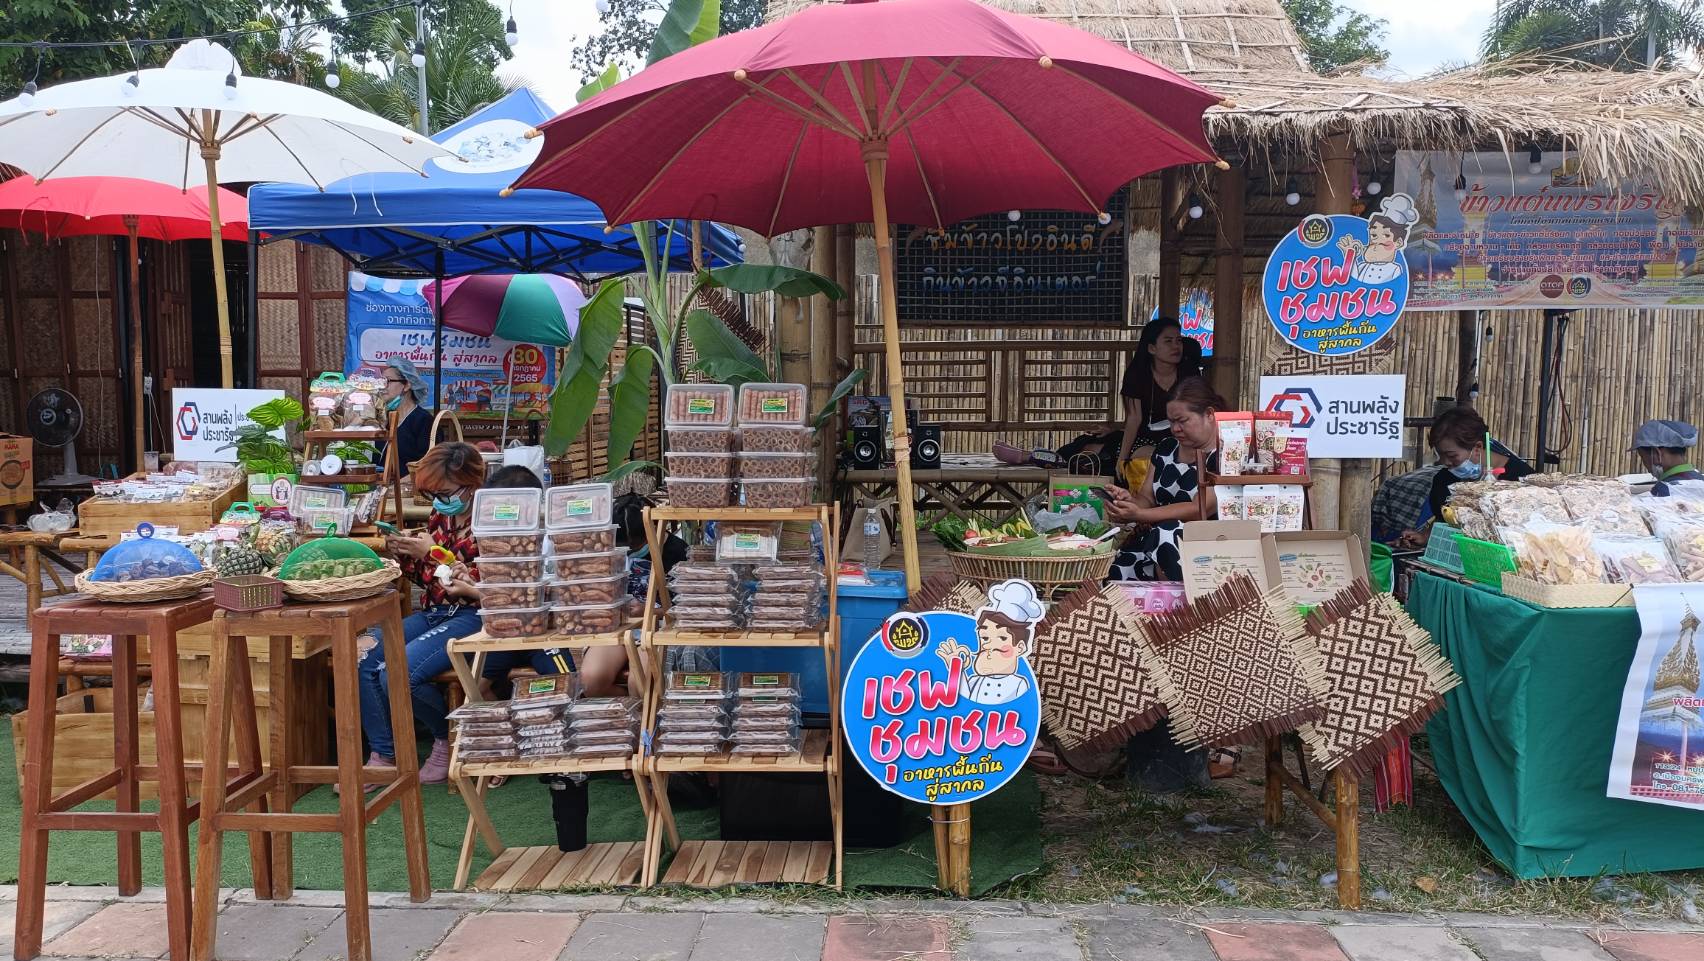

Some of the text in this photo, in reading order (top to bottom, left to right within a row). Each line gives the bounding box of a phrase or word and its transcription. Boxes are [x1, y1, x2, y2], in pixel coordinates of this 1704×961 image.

[1277, 248, 1357, 291] เชฟ
[1279, 287, 1396, 340] ชุมชน
[513, 348, 538, 365] 30
[513, 373, 538, 382] 2565
[202, 409, 233, 425] สานพลัง
[1328, 395, 1400, 414] สานพลัง
[1326, 415, 1400, 440] ประชารัฐ
[862, 656, 963, 719] เชฟ
[869, 710, 1026, 784] ชุมชน
[903, 753, 1003, 781] อาหารพื้นถิ่น
[925, 777, 985, 802] สู่สากล
